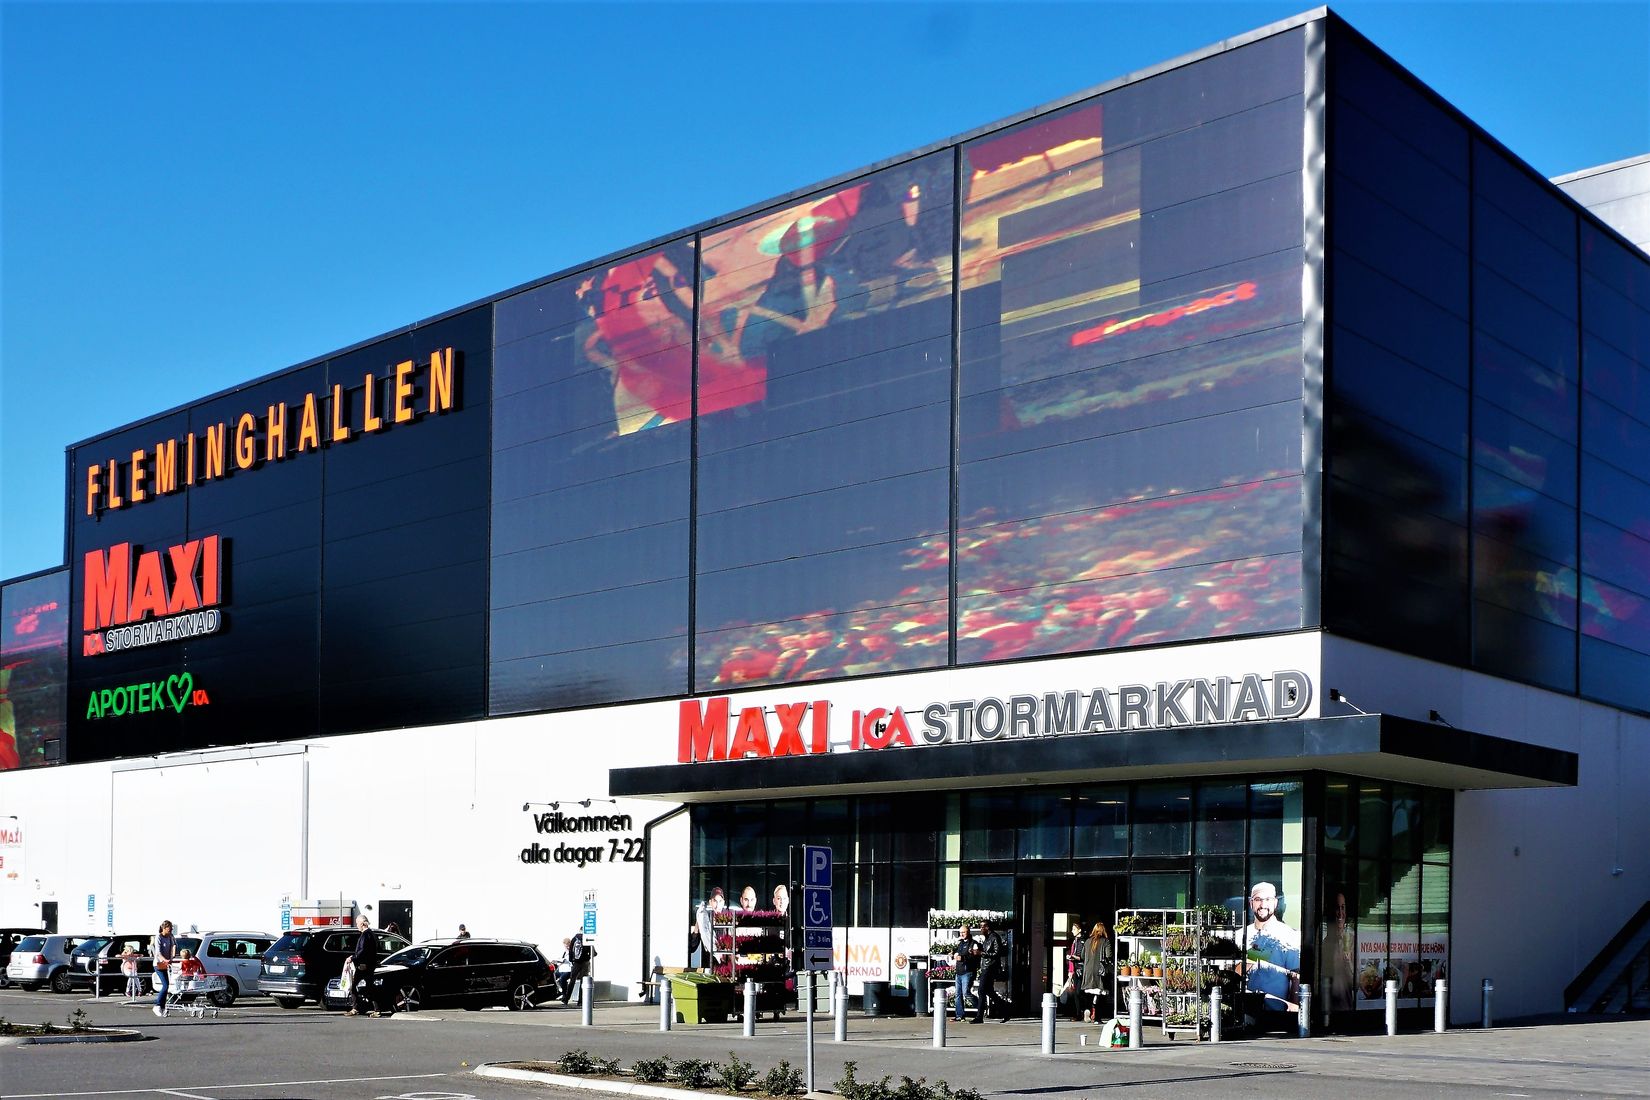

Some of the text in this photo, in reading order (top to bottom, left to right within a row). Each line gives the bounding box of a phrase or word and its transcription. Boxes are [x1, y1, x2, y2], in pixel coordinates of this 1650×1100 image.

[86, 347, 453, 516] FLEMINGHALLEN
[83, 534, 220, 631] MAXI
[83, 609, 220, 656] ICA STORMARKNAD
[87, 680, 209, 719] APOTEK ICA
[677, 669, 1312, 763] MAXI ICA STORMARKNAD
[533, 811, 632, 834] Välkommen
[520, 837, 644, 868] alla dagar 7-22
[811, 850, 828, 883] P
[847, 944, 882, 963] NYA
